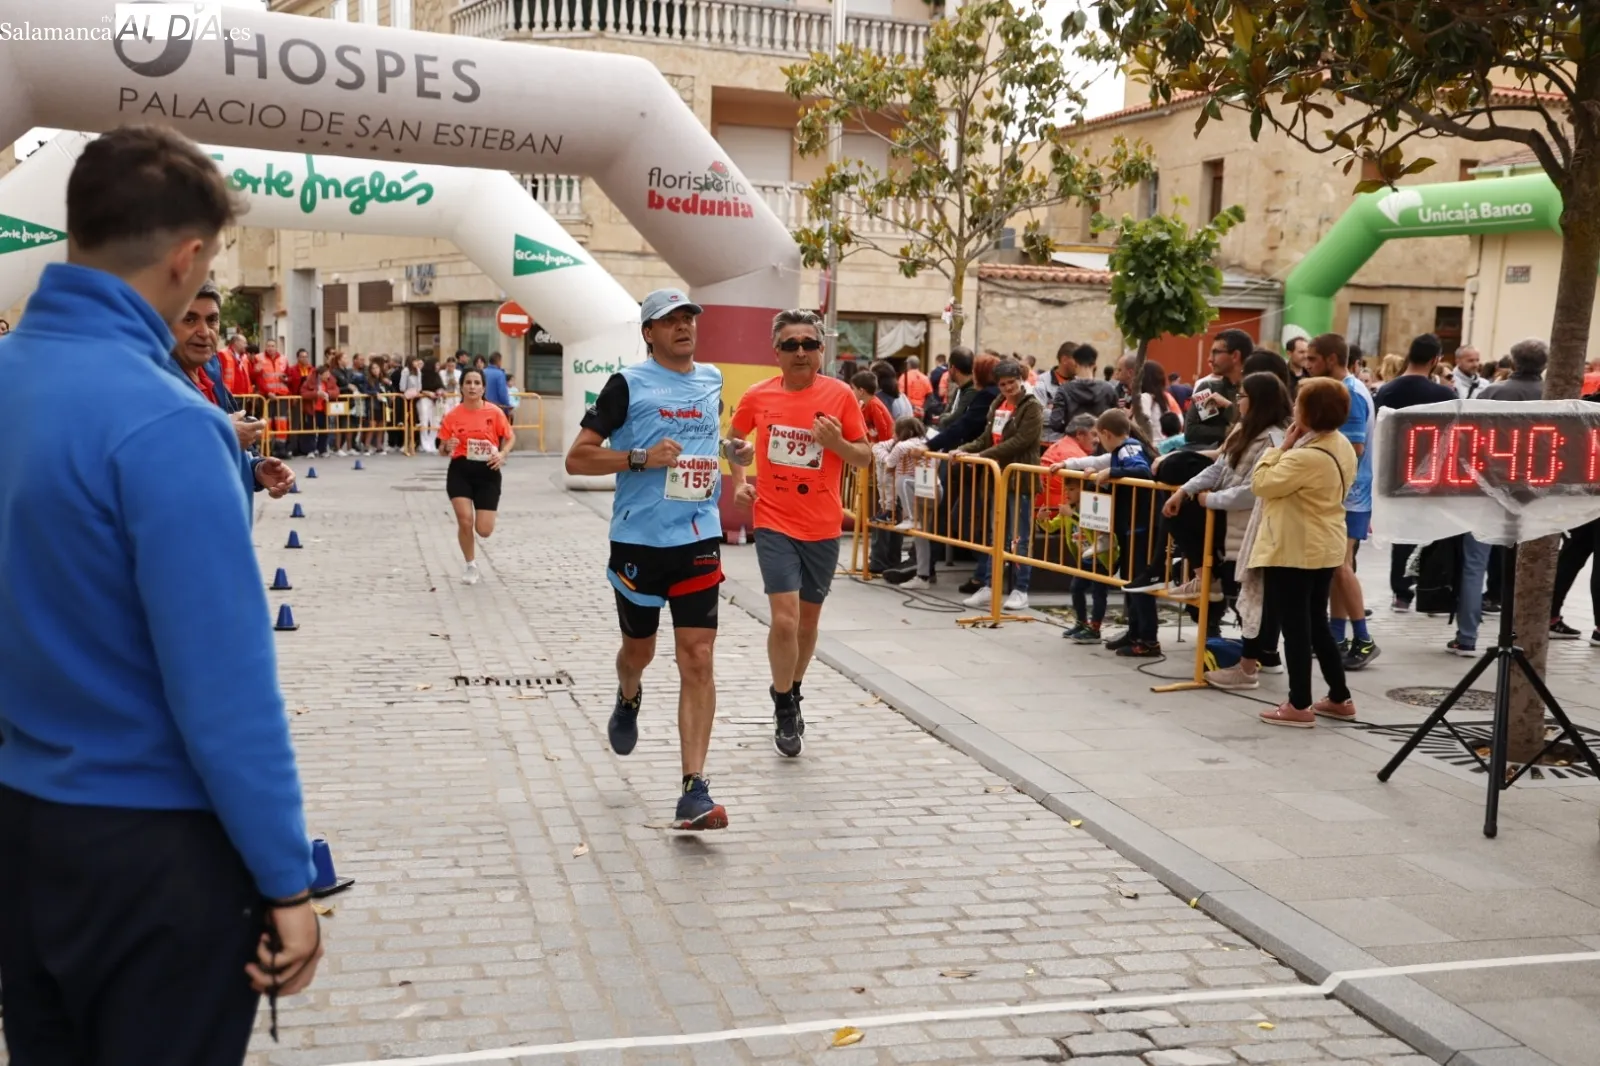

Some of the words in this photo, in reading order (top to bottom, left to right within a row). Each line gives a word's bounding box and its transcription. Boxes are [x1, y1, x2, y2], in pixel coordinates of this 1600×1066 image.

[224, 33, 482, 103] HOSPES
[119, 87, 286, 129] PALACIO
[300, 108, 345, 136] DE
[354, 114, 422, 142] SAN
[433, 122, 563, 156] ESTEBAN
[648, 166, 747, 195] floristería
[647, 190, 754, 218] bedunia
[1418, 202, 1479, 224] Unicaja
[1480, 202, 1532, 219] Banco
[573, 360, 583, 373] El
[584, 360, 614, 373] Corte
[474, 446, 492, 455] 273
[786, 441, 807, 457] 93
[682, 471, 711, 489] 155
